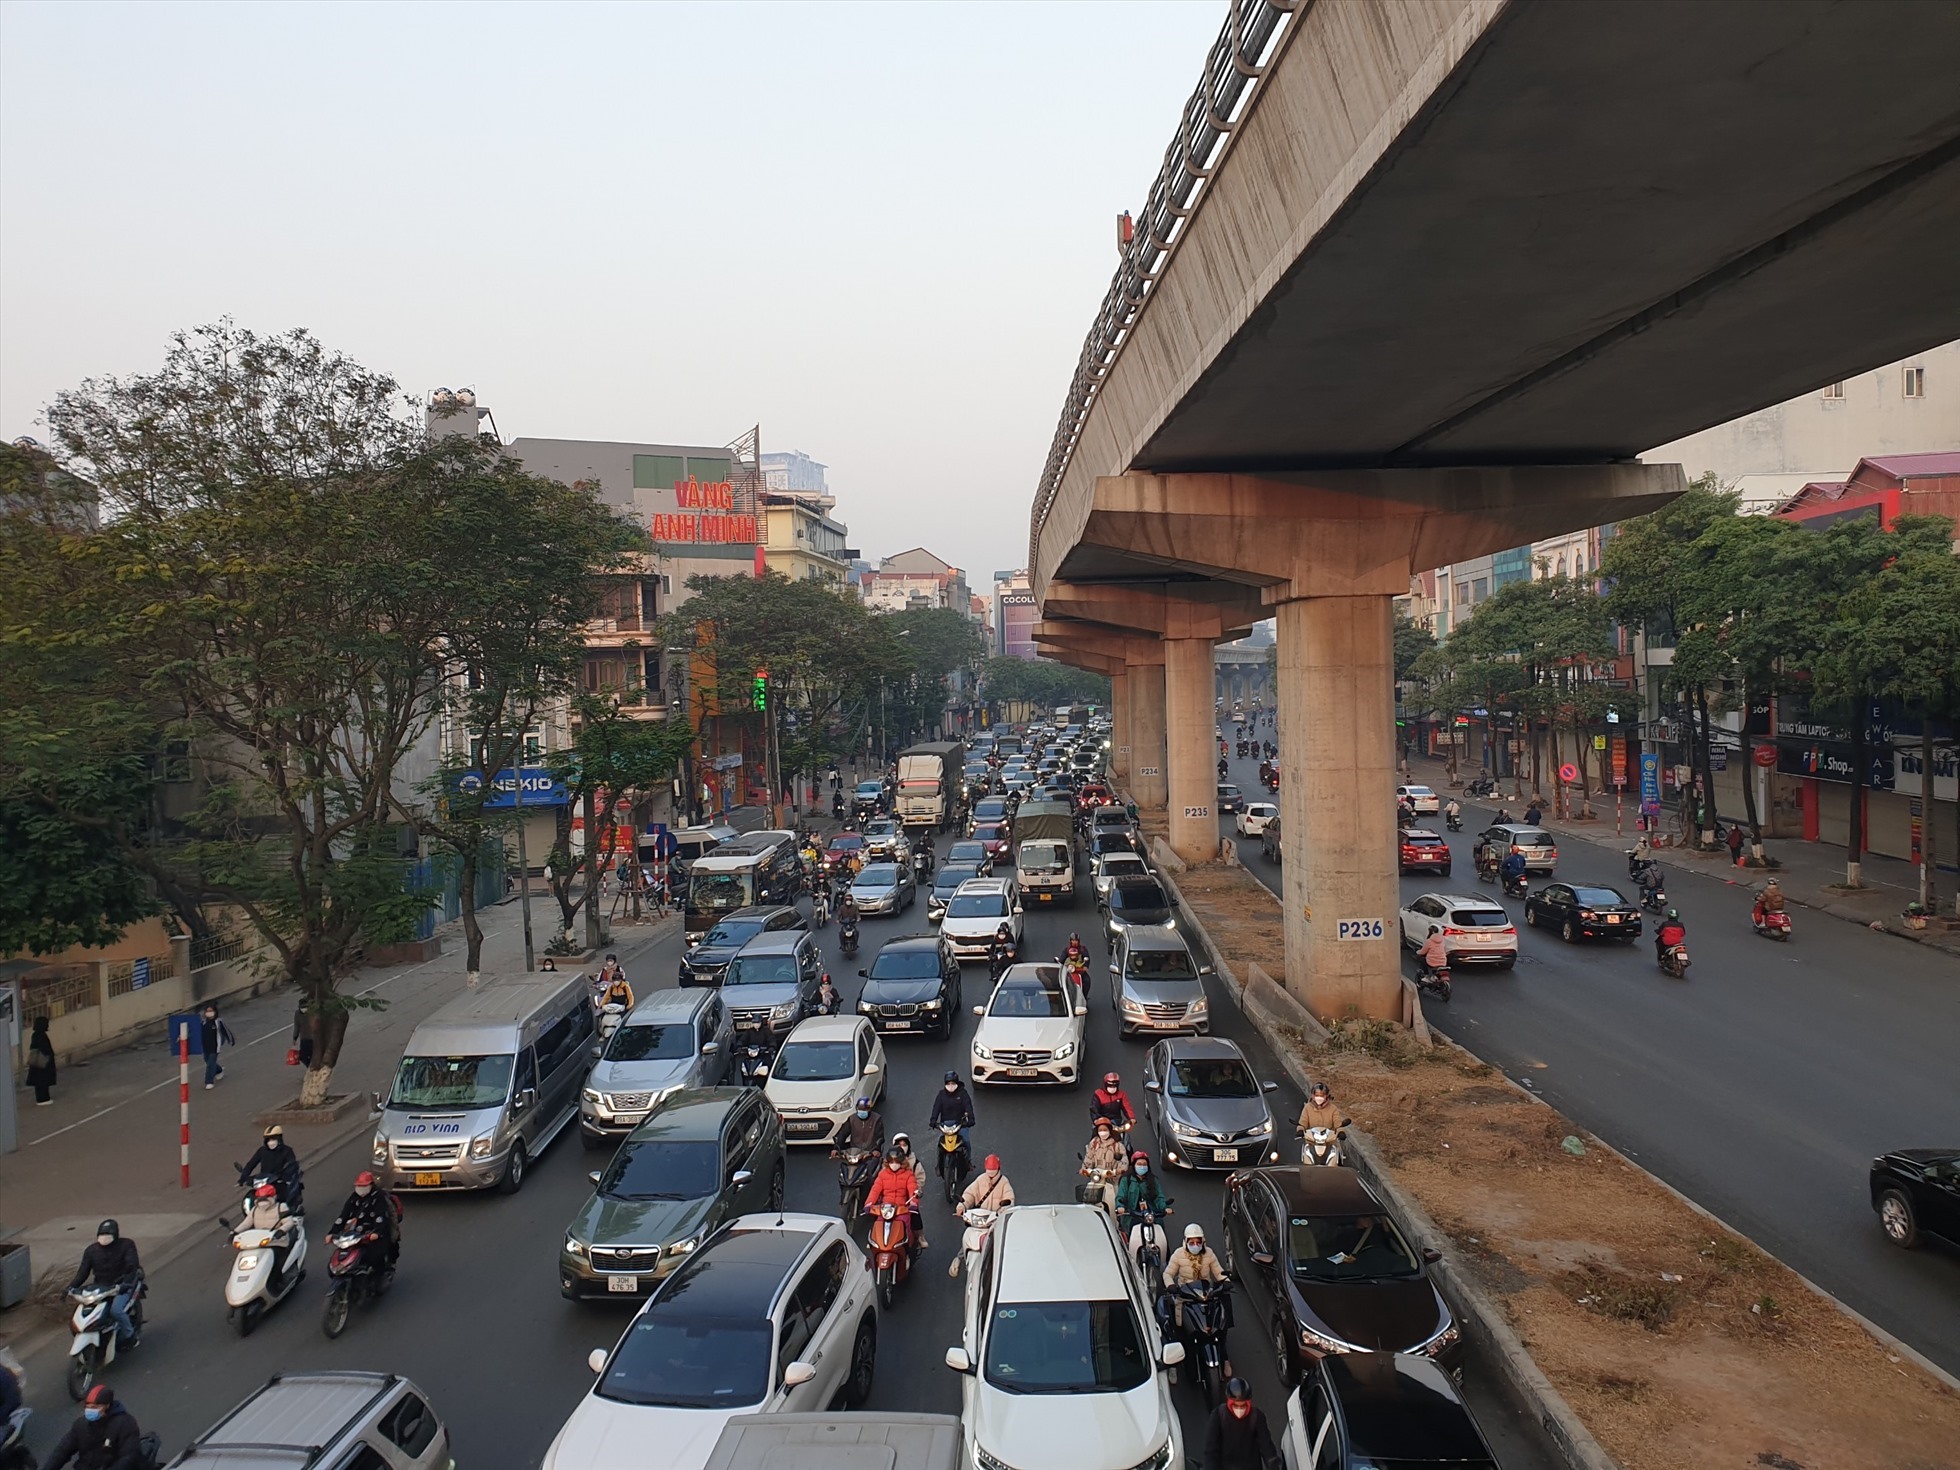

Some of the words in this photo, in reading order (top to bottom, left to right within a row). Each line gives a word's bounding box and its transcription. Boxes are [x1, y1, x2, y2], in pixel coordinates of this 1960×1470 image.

[674, 474, 733, 509] VÀNG
[653, 512, 697, 542] ANH
[701, 514, 757, 543] MINH
[1185, 807, 1208, 817] P235
[1340, 921, 1382, 938] P236
